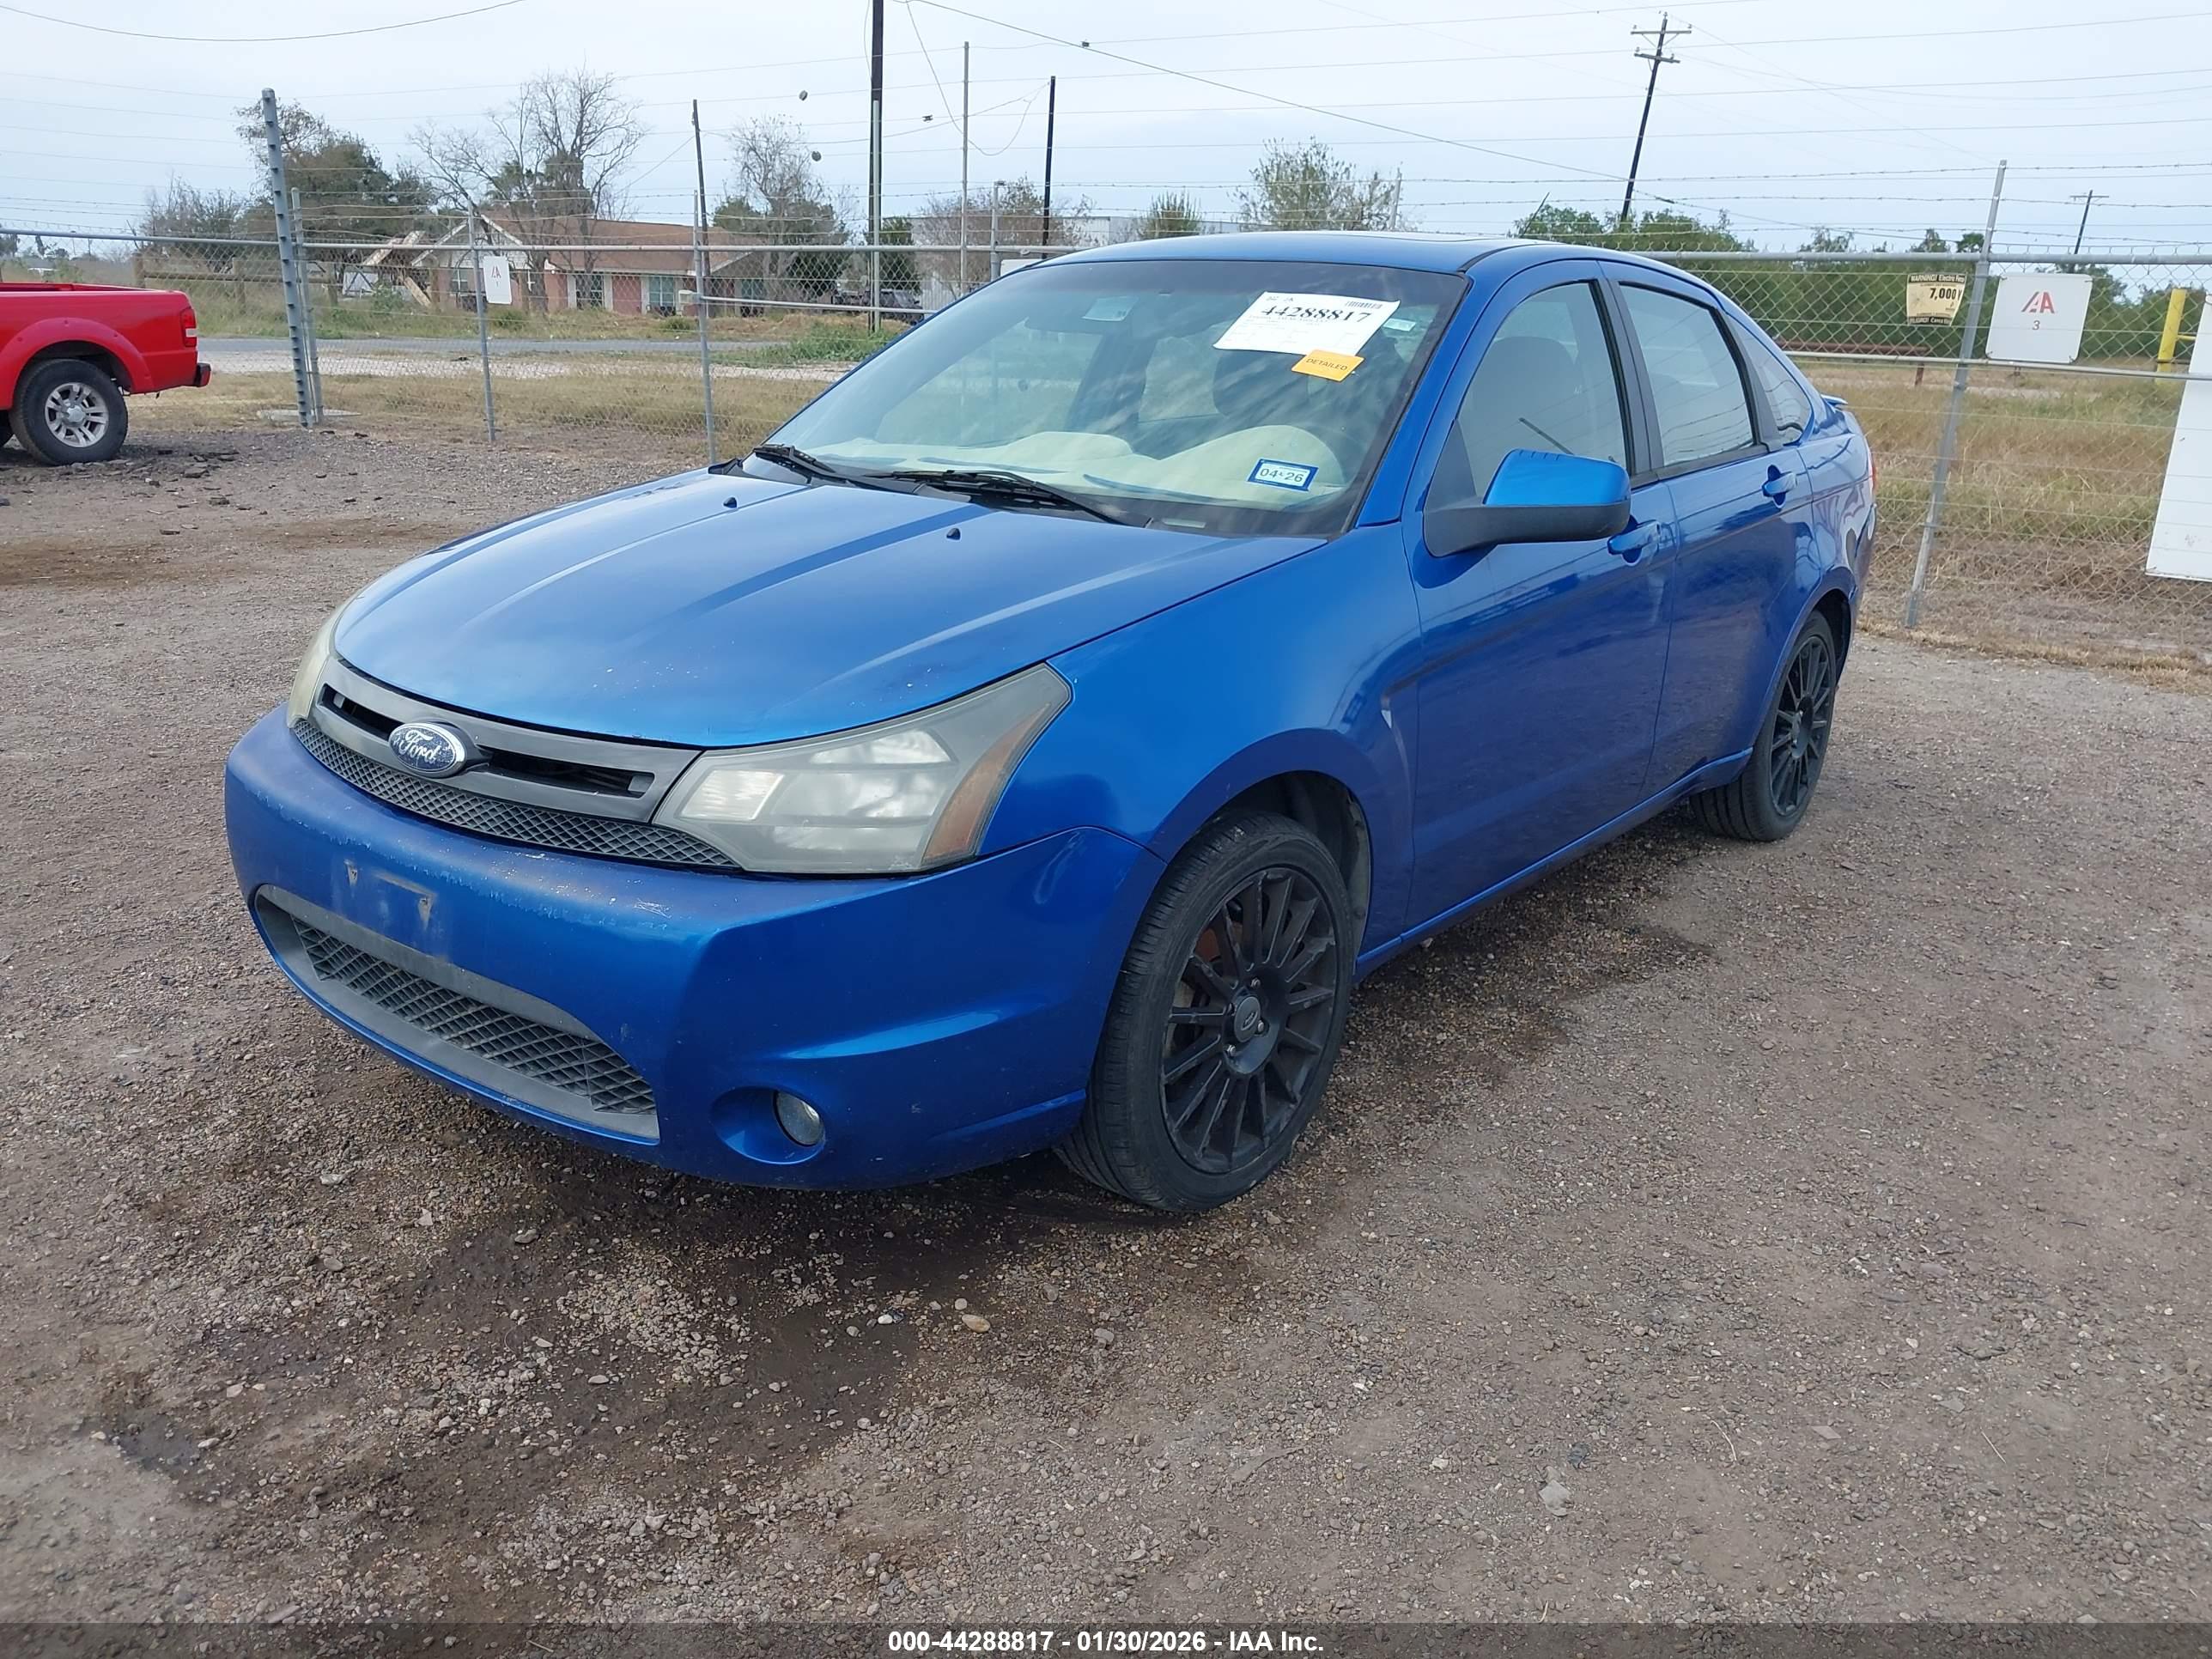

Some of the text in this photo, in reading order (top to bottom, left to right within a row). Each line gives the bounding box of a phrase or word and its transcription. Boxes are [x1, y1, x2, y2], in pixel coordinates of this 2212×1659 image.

[1929, 288, 1956, 301] 7,000
[1261, 305, 1372, 323] 44288817
[2032, 320, 2040, 331] 3
[1306, 357, 1348, 371] DETAILED
[398, 729, 441, 764] Ford
